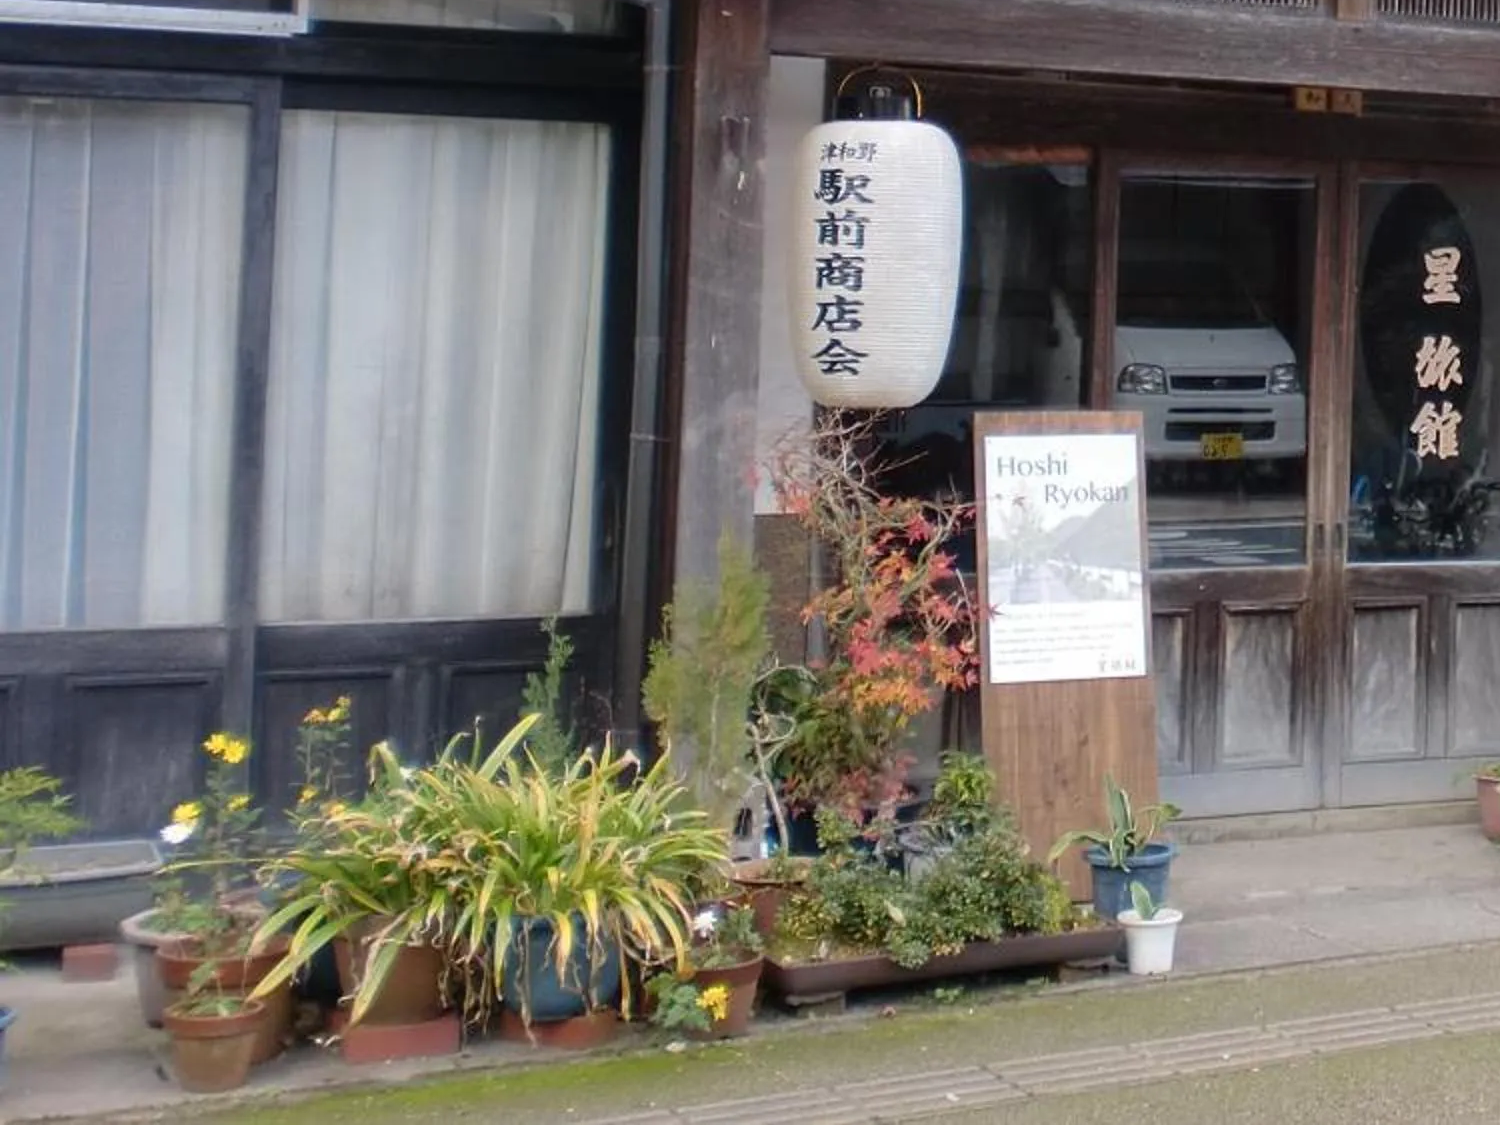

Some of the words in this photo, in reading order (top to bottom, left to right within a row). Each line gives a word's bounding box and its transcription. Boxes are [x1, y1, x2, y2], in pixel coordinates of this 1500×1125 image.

[820, 141, 877, 163] 津和野
[810, 168, 874, 376] 駅前商店会
[1410, 246, 1463, 460] 星旅館
[996, 452, 1068, 478] Hoshi
[1044, 480, 1129, 509] Ryokan
